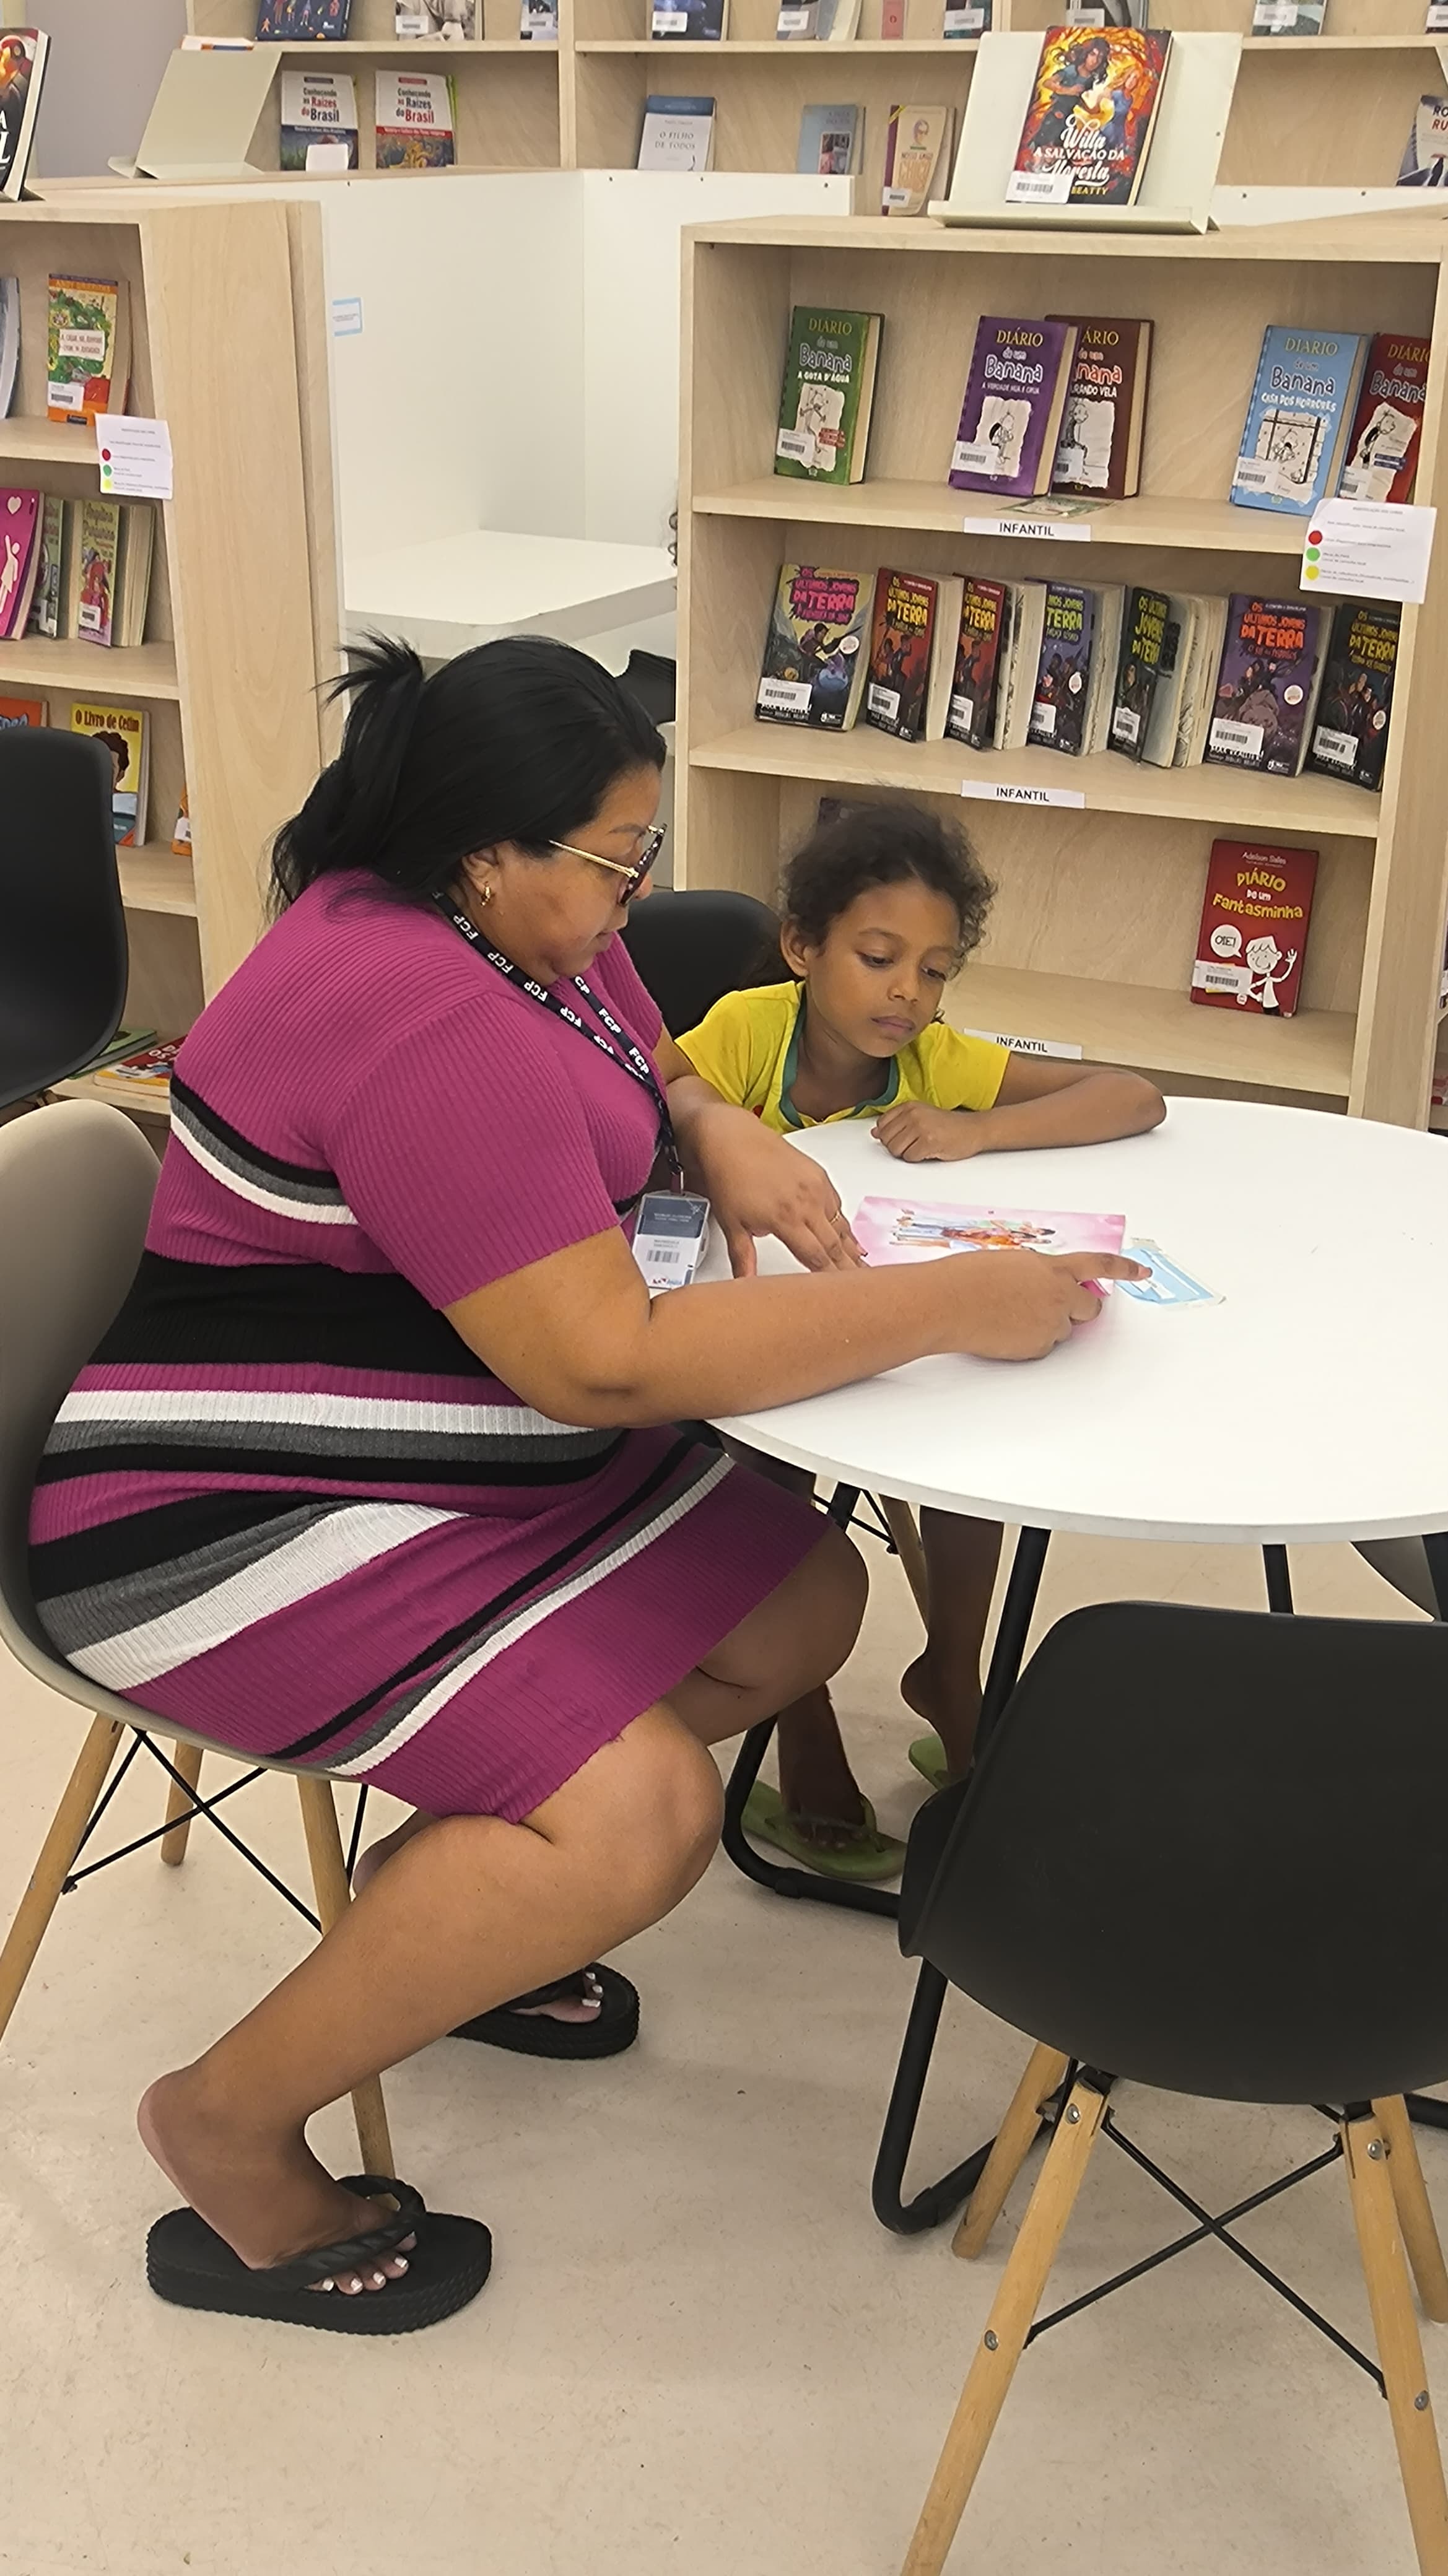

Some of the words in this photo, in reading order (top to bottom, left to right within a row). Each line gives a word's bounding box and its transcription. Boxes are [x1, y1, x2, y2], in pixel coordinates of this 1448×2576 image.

[311, 108, 339, 123] Brasil
[406, 109, 434, 124] Brasil
[1060, 114, 1107, 149] Willa
[1033, 147, 1042, 157] A
[1108, 149, 1125, 161] DA
[997, 326, 1044, 347] DIÁRIO
[1082, 326, 1119, 346] ÁRIO
[799, 342, 852, 373] Banana
[797, 371, 803, 379] A
[985, 354, 1043, 384] Banana
[1076, 363, 1122, 385] nana
[1073, 383, 1098, 395] RANDO
[1099, 386, 1117, 398] VELA
[1270, 365, 1335, 396] Banana
[999, 523, 1054, 536] INFANTIL
[808, 590, 854, 612] TERRA
[897, 599, 928, 626] TERRA
[970, 606, 995, 631] TERRA
[1047, 607, 1083, 631] TERRA
[1257, 625, 1303, 649] TERRA
[1361, 635, 1395, 661] TERRA
[76, 709, 82, 725] O
[84, 710, 105, 728] Livro
[107, 714, 117, 729] de
[996, 787, 1049, 802] INFANTIL
[1236, 867, 1286, 892] DIÁRIO
[1212, 892, 1304, 919] Fantasminha
[453, 915, 479, 940] FCP
[487, 952, 514, 974] FCP
[524, 980, 548, 1002] FCP
[574, 975, 590, 995] CP
[560, 1006, 582, 1028] FCP
[598, 1007, 621, 1033] FCP
[996, 1035, 1048, 1053] INFANTIL
[629, 1046, 650, 1075] FCP
